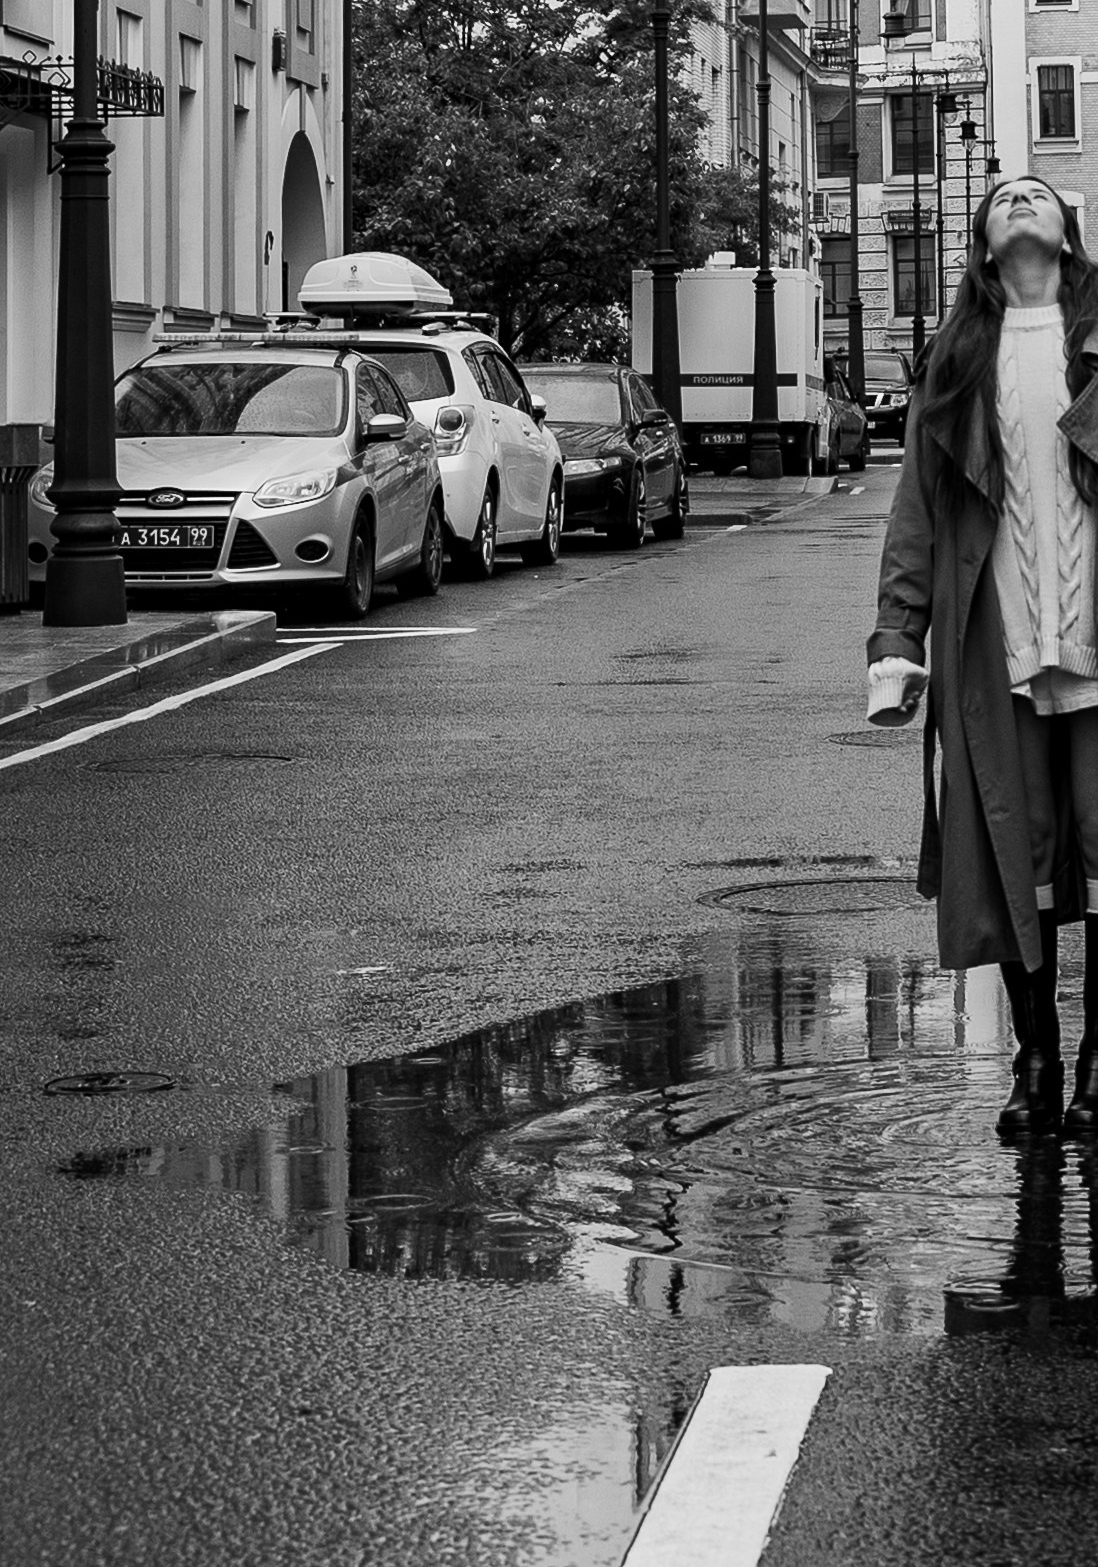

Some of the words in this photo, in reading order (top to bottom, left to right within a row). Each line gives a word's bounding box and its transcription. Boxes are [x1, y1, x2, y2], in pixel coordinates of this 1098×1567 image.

[693, 376, 744, 384] ПОЛИЦИЯ
[138, 528, 180, 546] 3154
[190, 528, 208, 541] 99
